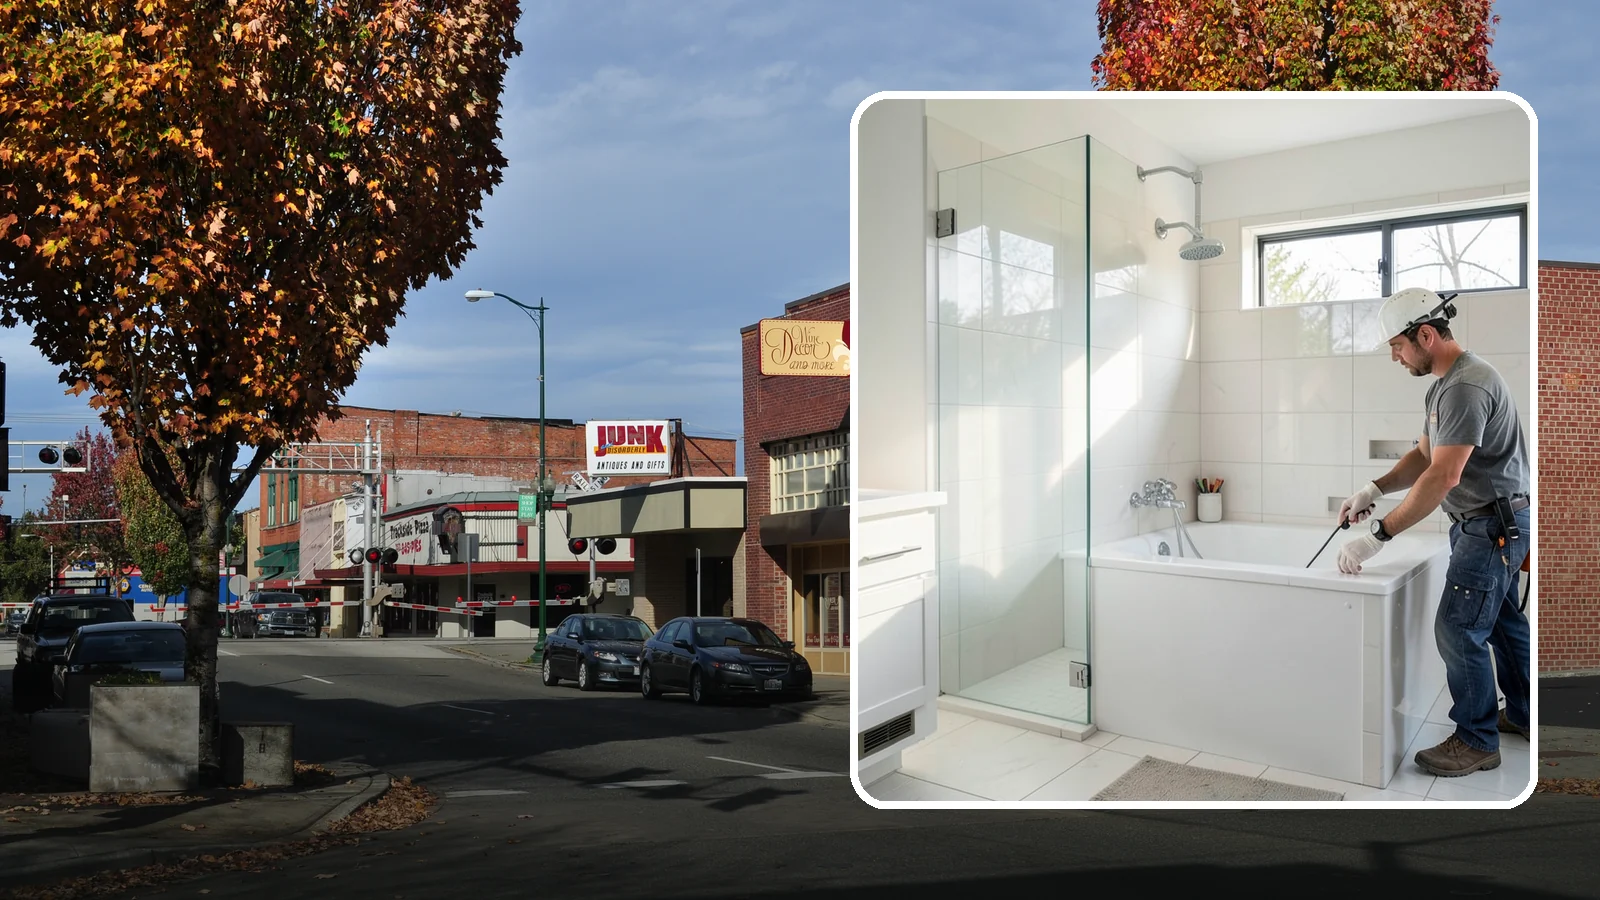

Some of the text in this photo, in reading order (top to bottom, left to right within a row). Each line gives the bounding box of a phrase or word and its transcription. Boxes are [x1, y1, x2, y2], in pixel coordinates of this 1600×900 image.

[791, 325, 824, 345] Wine
[765, 328, 831, 365] Decor
[595, 425, 664, 457] JUNK
[607, 446, 646, 454] DISORDERLY
[597, 460, 665, 470] ANTIQUES AND GIFTS
